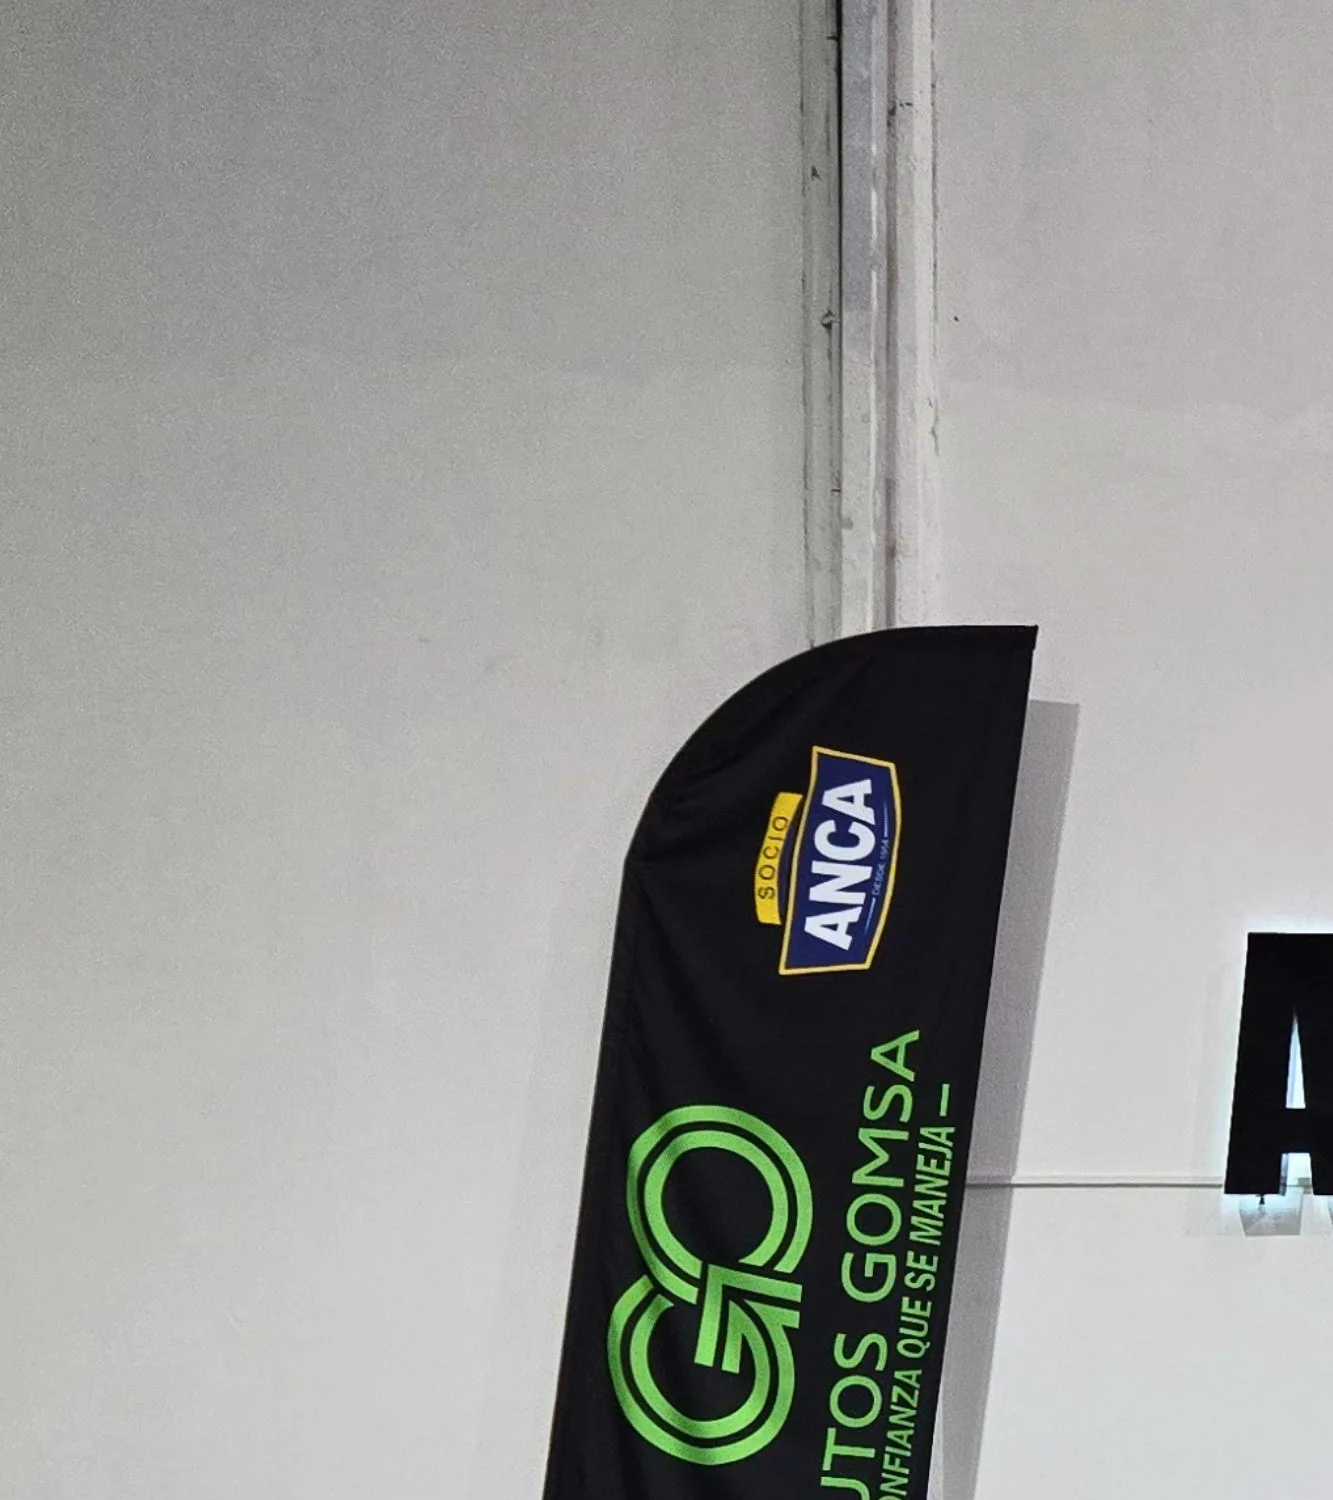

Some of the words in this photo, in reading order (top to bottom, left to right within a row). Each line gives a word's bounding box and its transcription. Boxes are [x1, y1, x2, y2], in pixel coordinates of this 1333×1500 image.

[758, 815, 789, 900] SOCIO
[804, 778, 876, 951] ANCA
[841, 1031, 919, 1302] GOMSA
[910, 1126, 955, 1244] MANEJA
[608, 1104, 813, 1466] GO
[894, 1298, 930, 1358] QUE
[903, 1252, 938, 1289] SE
